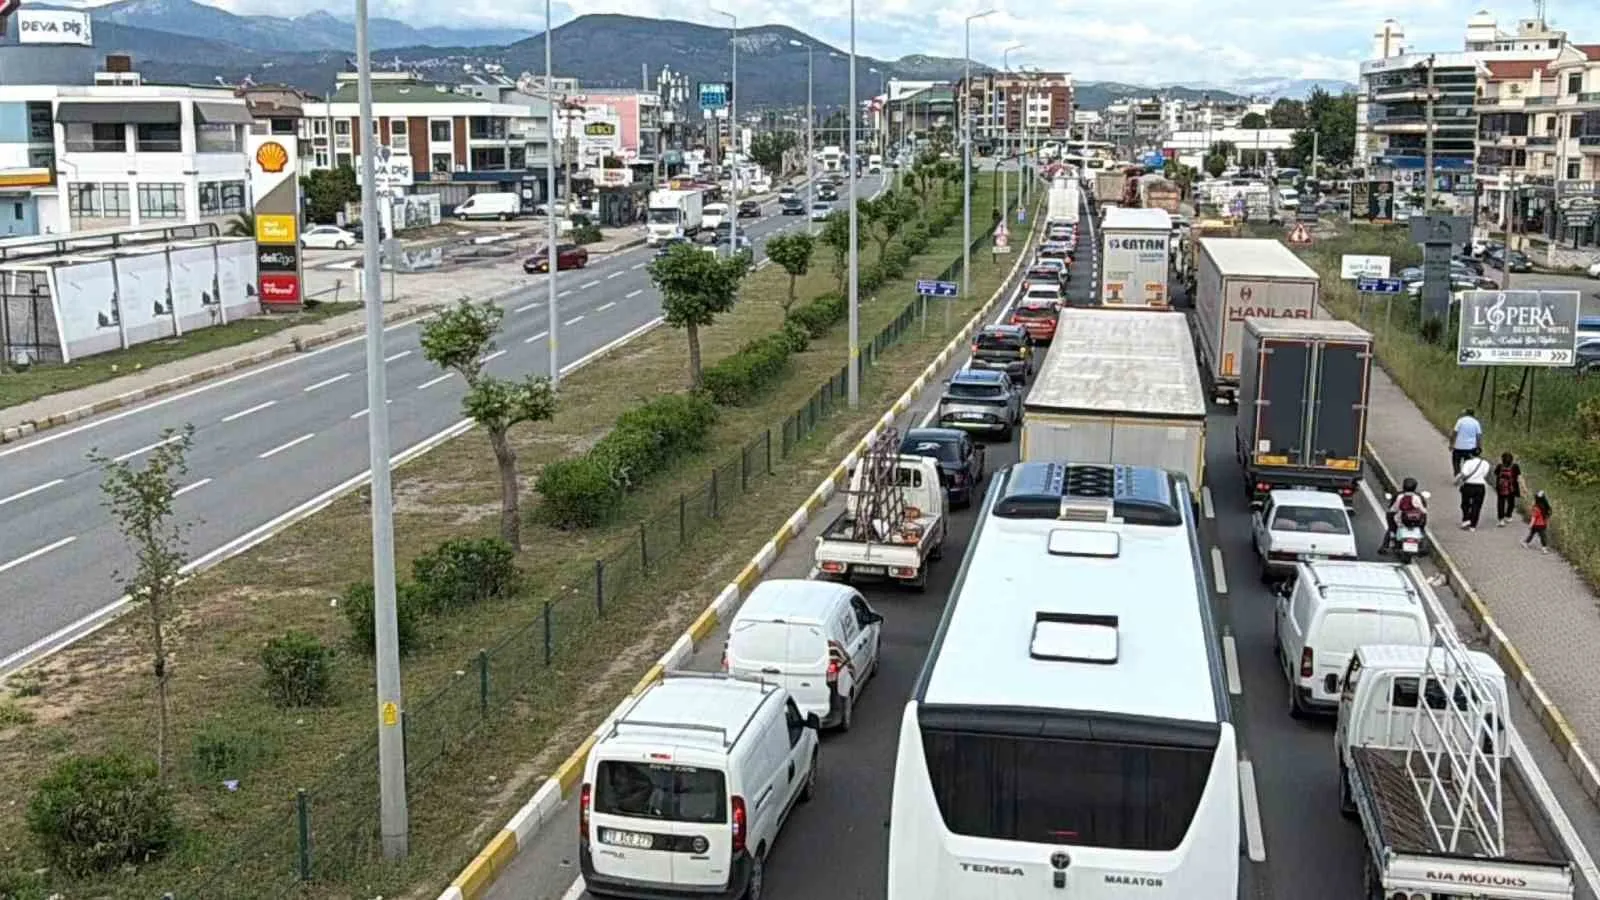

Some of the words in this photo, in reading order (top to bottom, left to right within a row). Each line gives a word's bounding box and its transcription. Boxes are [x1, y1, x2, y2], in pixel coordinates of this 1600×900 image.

[21, 21, 58, 32] DEVA
[1229, 306, 1313, 319] HANLAR
[960, 862, 1025, 876] TEMSA
[1104, 875, 1163, 887] MARATON
[1426, 871, 1454, 882] KIA
[1458, 873, 1527, 887] MOTORS
